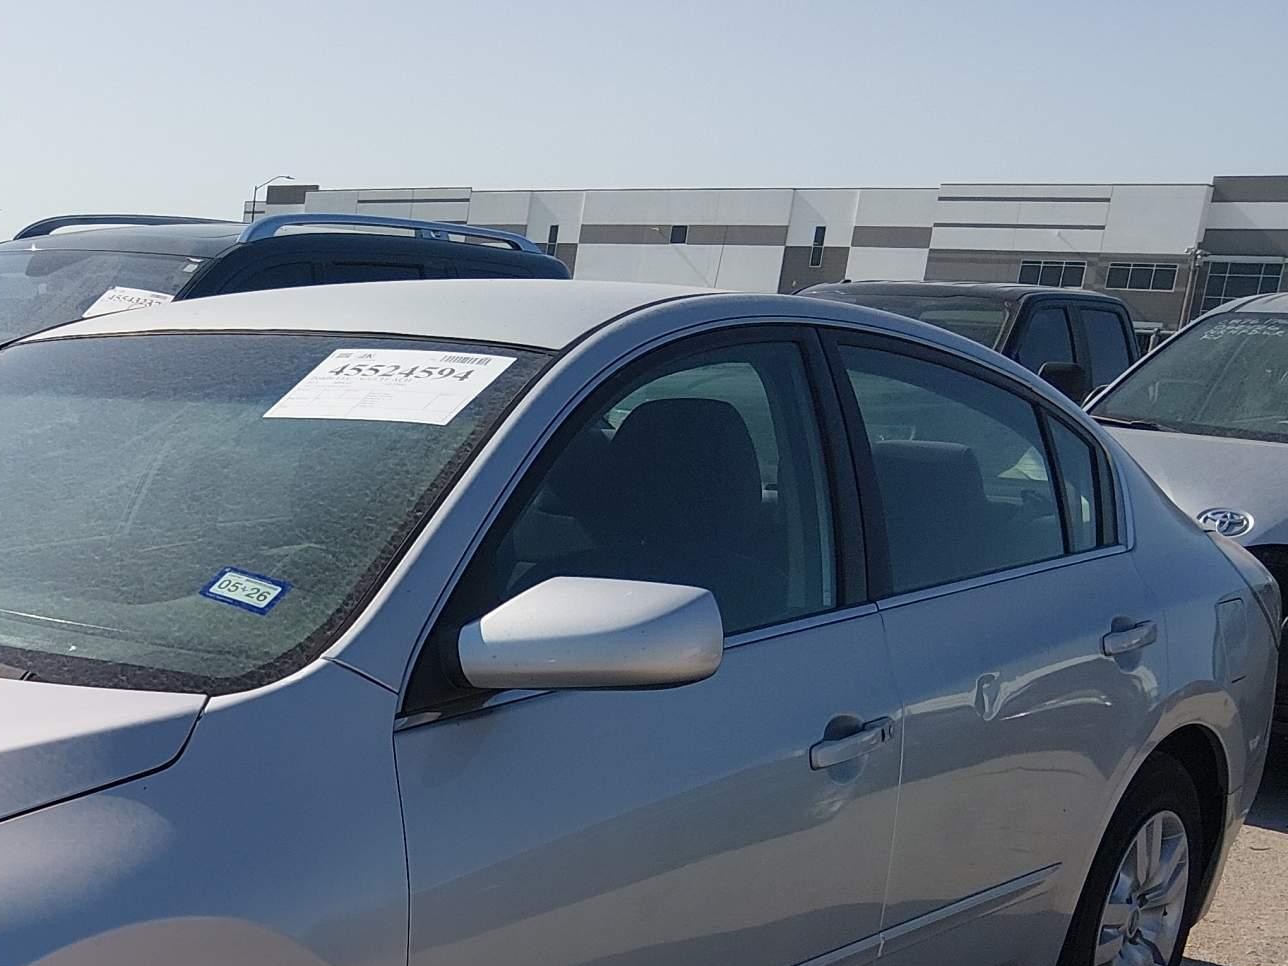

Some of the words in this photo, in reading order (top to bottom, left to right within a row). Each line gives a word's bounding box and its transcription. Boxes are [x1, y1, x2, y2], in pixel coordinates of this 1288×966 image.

[327, 362, 475, 382] 45524594
[217, 579, 242, 593] 05
[245, 587, 271, 602] 26
